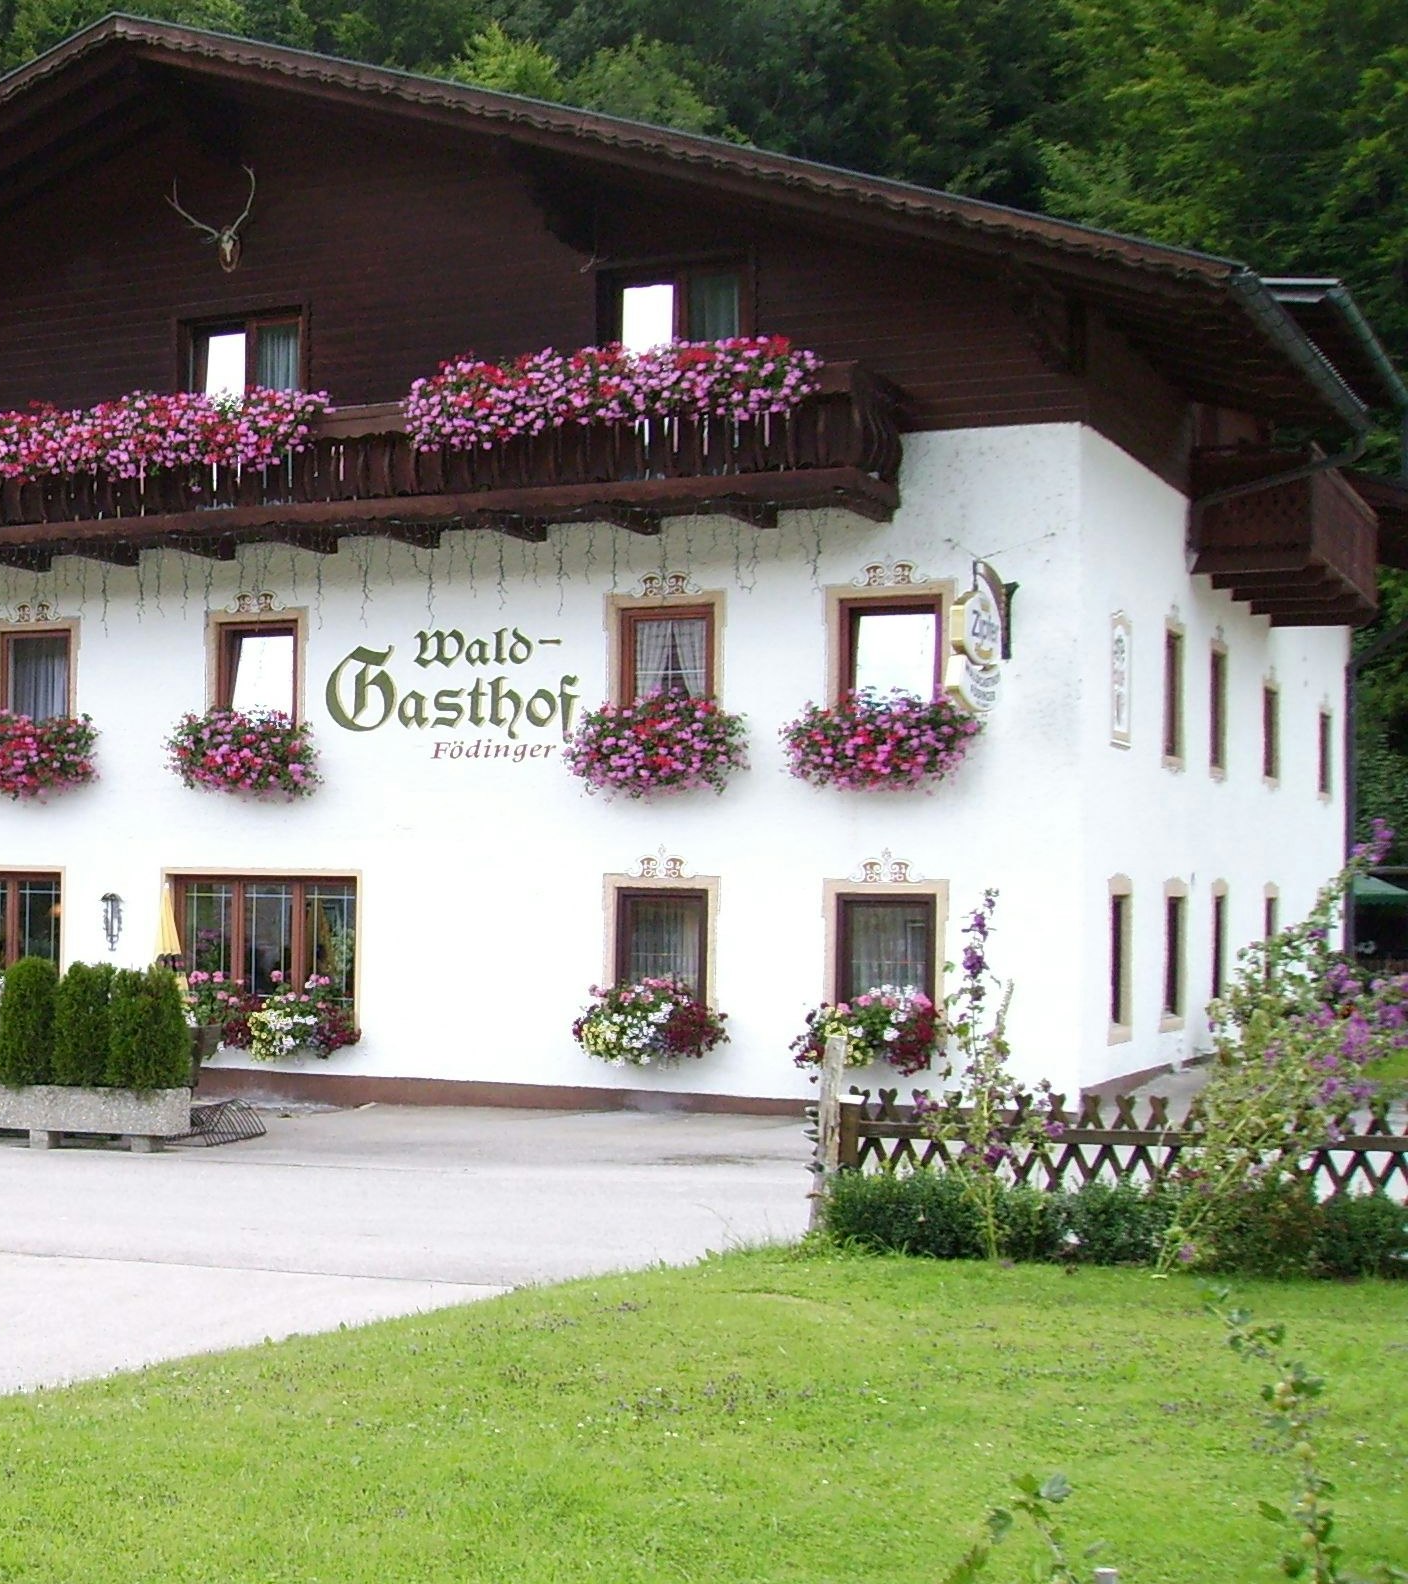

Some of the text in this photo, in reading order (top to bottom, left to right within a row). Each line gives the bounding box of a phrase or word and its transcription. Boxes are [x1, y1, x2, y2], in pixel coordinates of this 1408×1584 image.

[413, 627, 562, 668] Wald-
[325, 644, 580, 743] Gasthof
[430, 739, 557, 763] Födinger
